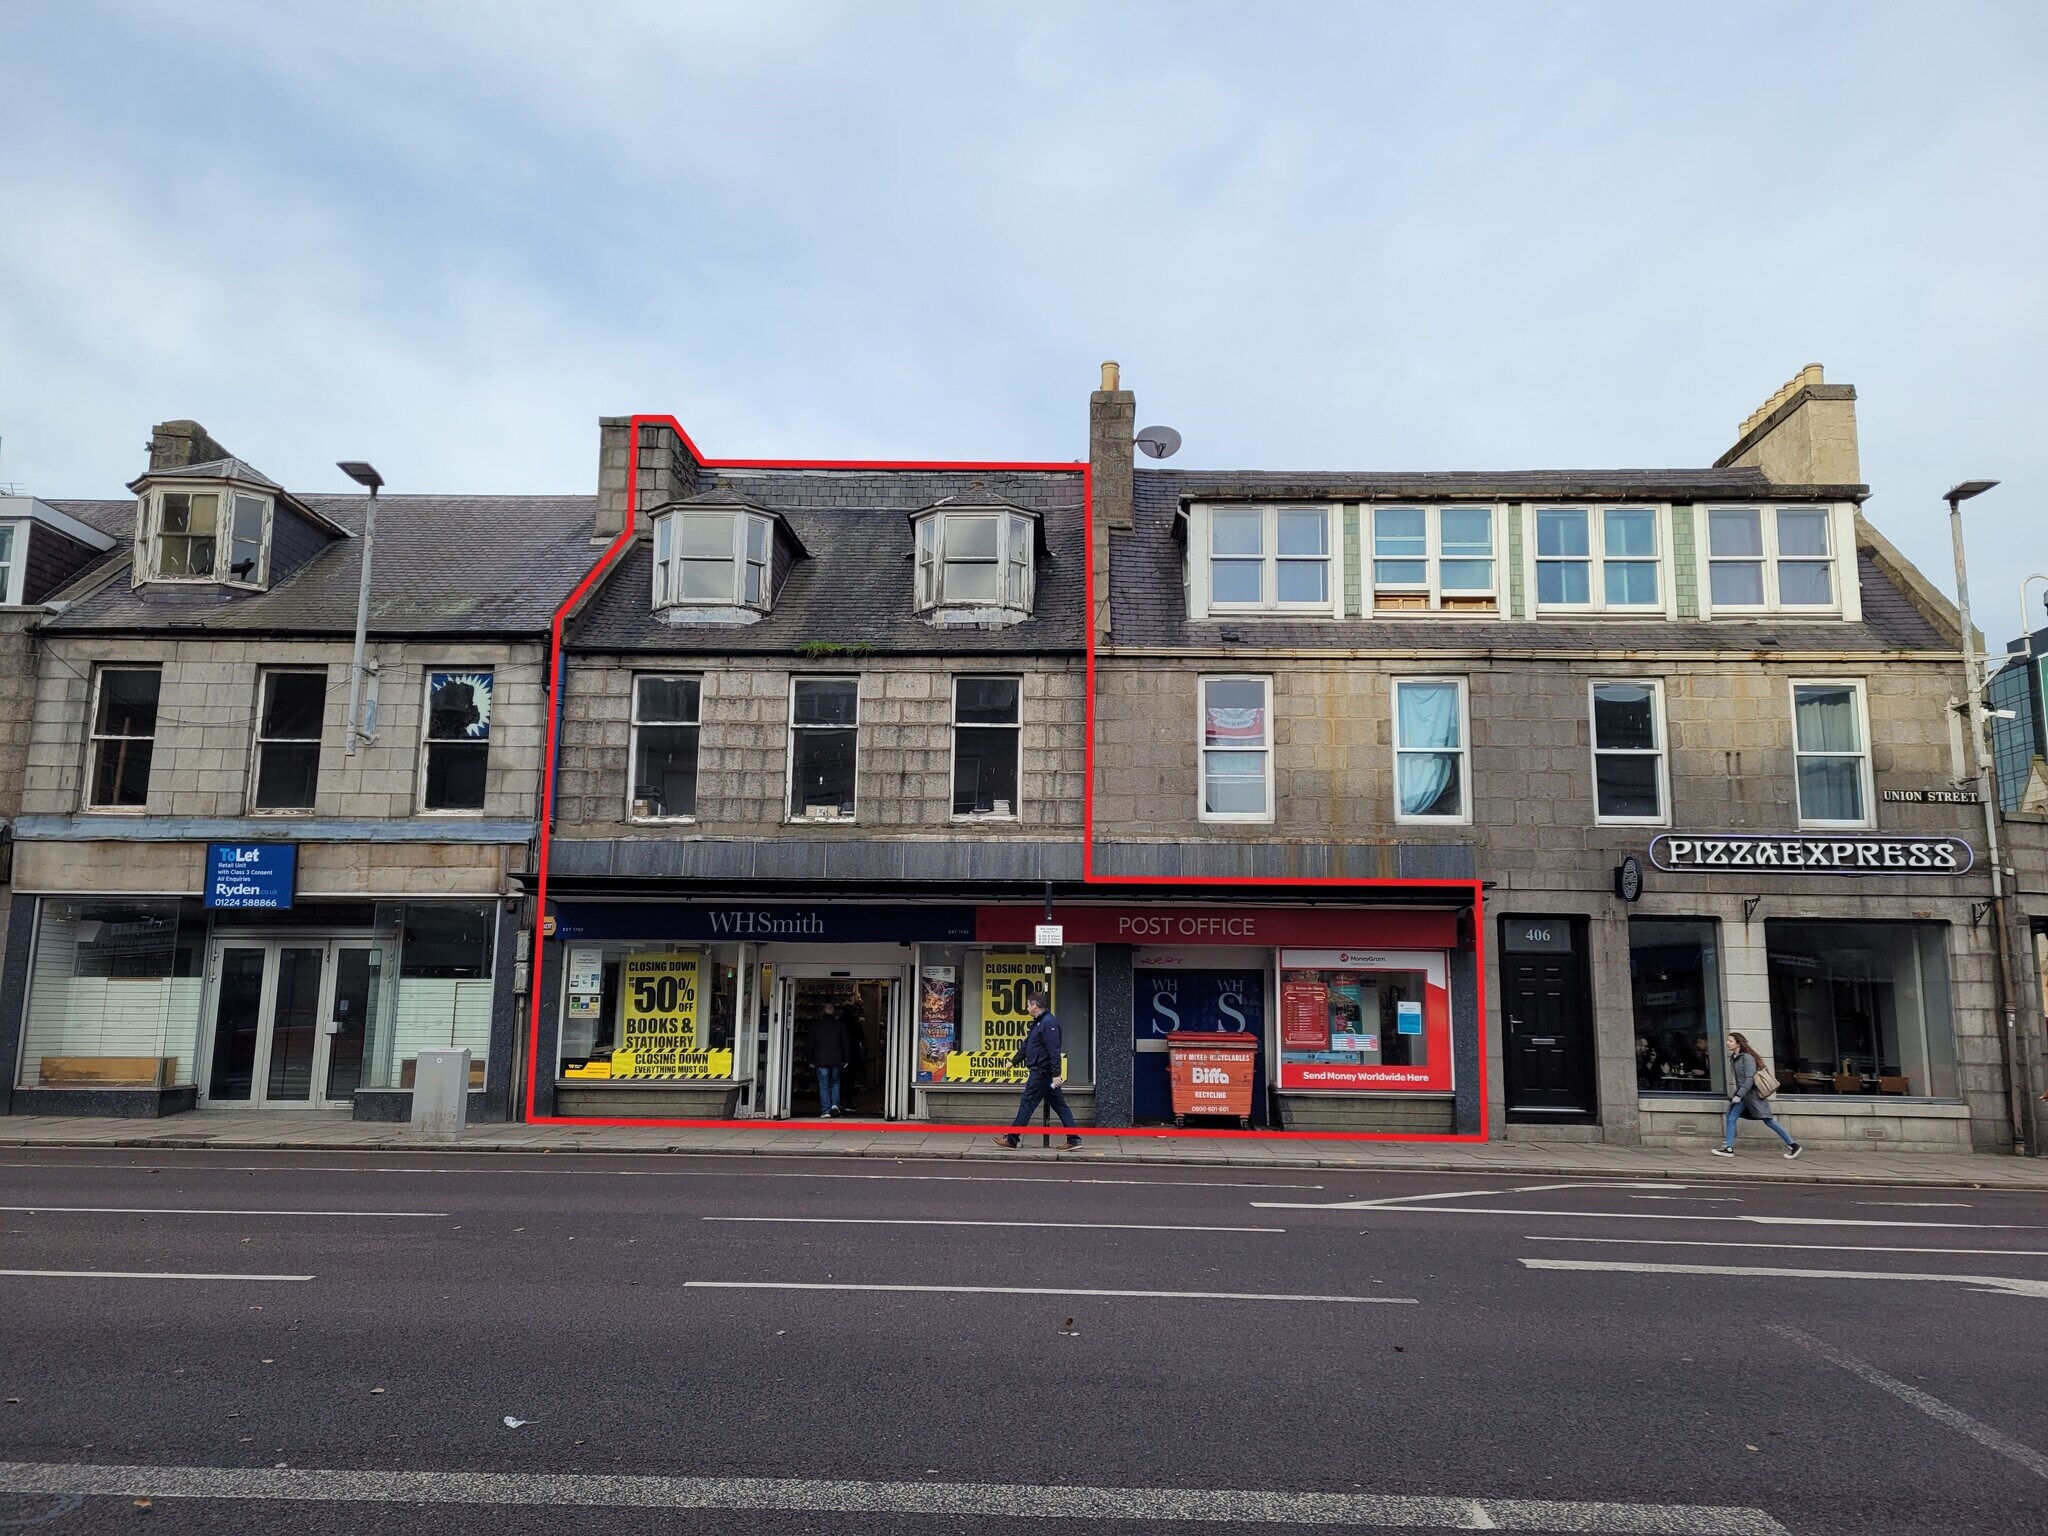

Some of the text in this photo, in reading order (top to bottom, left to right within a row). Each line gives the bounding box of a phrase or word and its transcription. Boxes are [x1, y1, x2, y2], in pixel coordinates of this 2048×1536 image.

[1883, 790, 1978, 803] UNION STREET
[1668, 840, 1957, 867] PIZZAEXPRESS
[215, 899, 277, 907] 01224 588866
[708, 911, 825, 934] WHSmith
[1119, 917, 1256, 936] POST OFFICE
[1525, 929, 1551, 941] 406
[628, 961, 696, 972] CLOSING DOWN
[985, 963, 1045, 974] CLOSING DOW
[1152, 979, 1178, 991] WH
[1217, 980, 1244, 992] WH
[634, 976, 695, 1013] 50%
[678, 1003, 694, 1012] OFF
[1152, 992, 1180, 1034] S
[1217, 992, 1246, 1033] S
[626, 1018, 694, 1034] BOOKS &
[626, 1036, 694, 1048] STATIONERY
[635, 1053, 709, 1065] CLOSING DOWN
[970, 1069, 1011, 1077] EVERYTHING
[1192, 1068, 1229, 1084] Biffa
[1303, 1071, 1429, 1082] Send Money Worldwide Here
